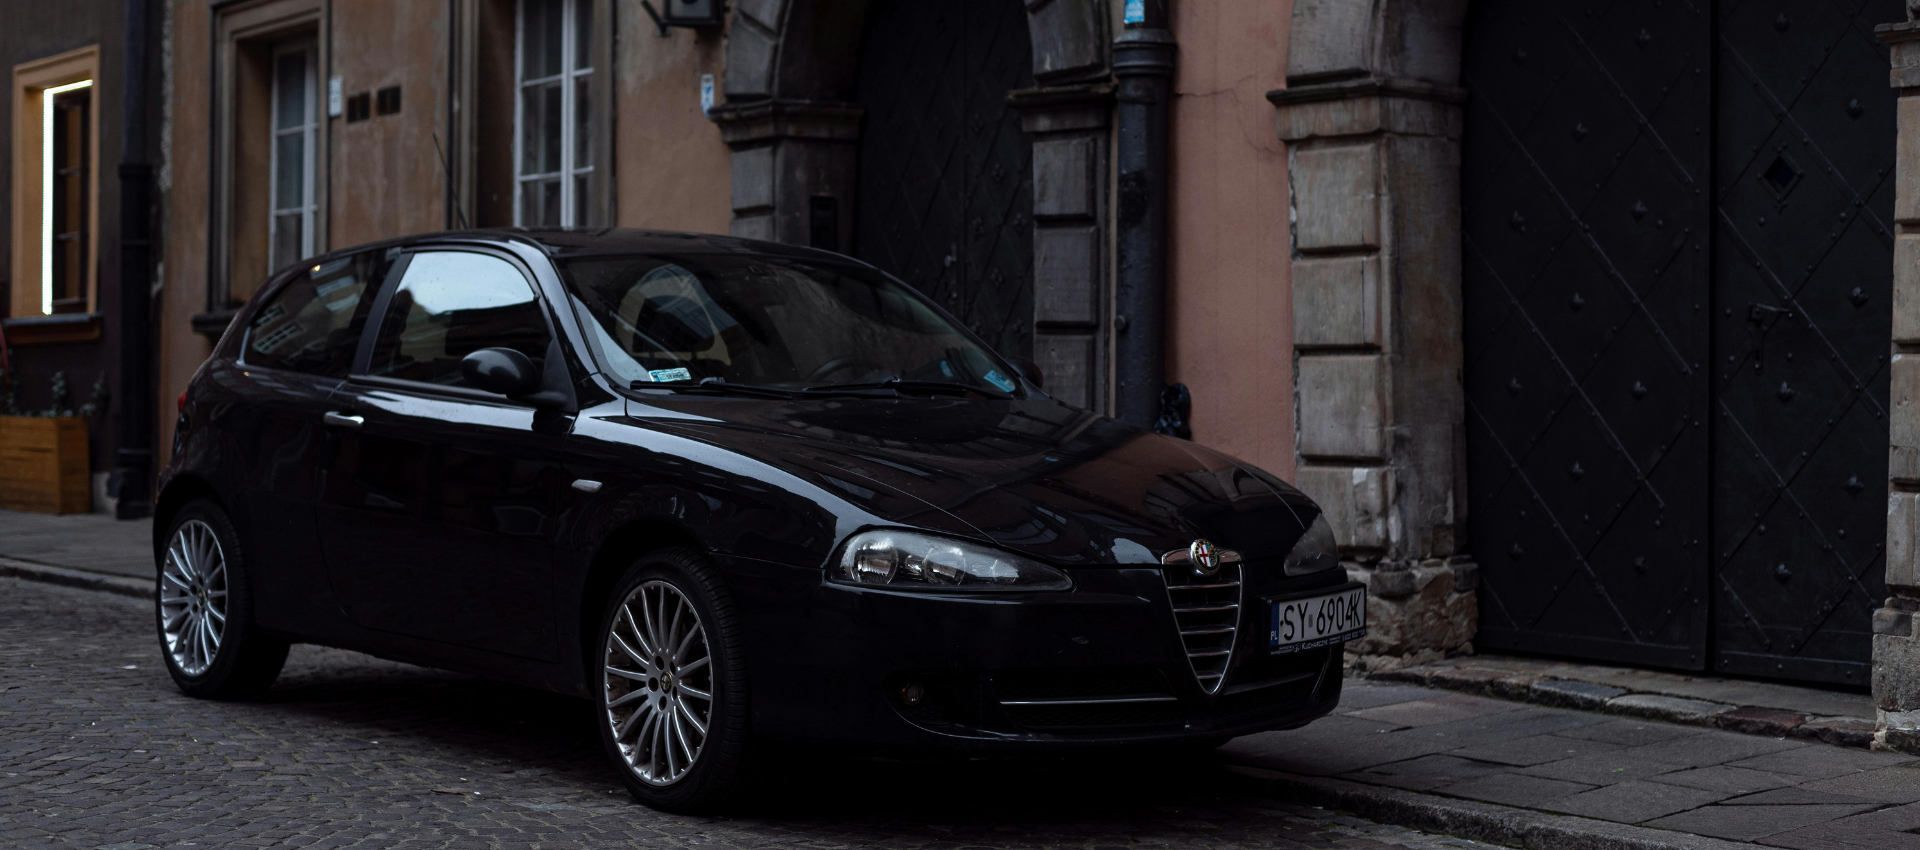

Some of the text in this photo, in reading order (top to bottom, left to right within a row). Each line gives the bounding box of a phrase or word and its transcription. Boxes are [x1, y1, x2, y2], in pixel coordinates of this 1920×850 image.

[1284, 592, 1361, 640] SY 6904K
[1270, 630, 1278, 641] PL
